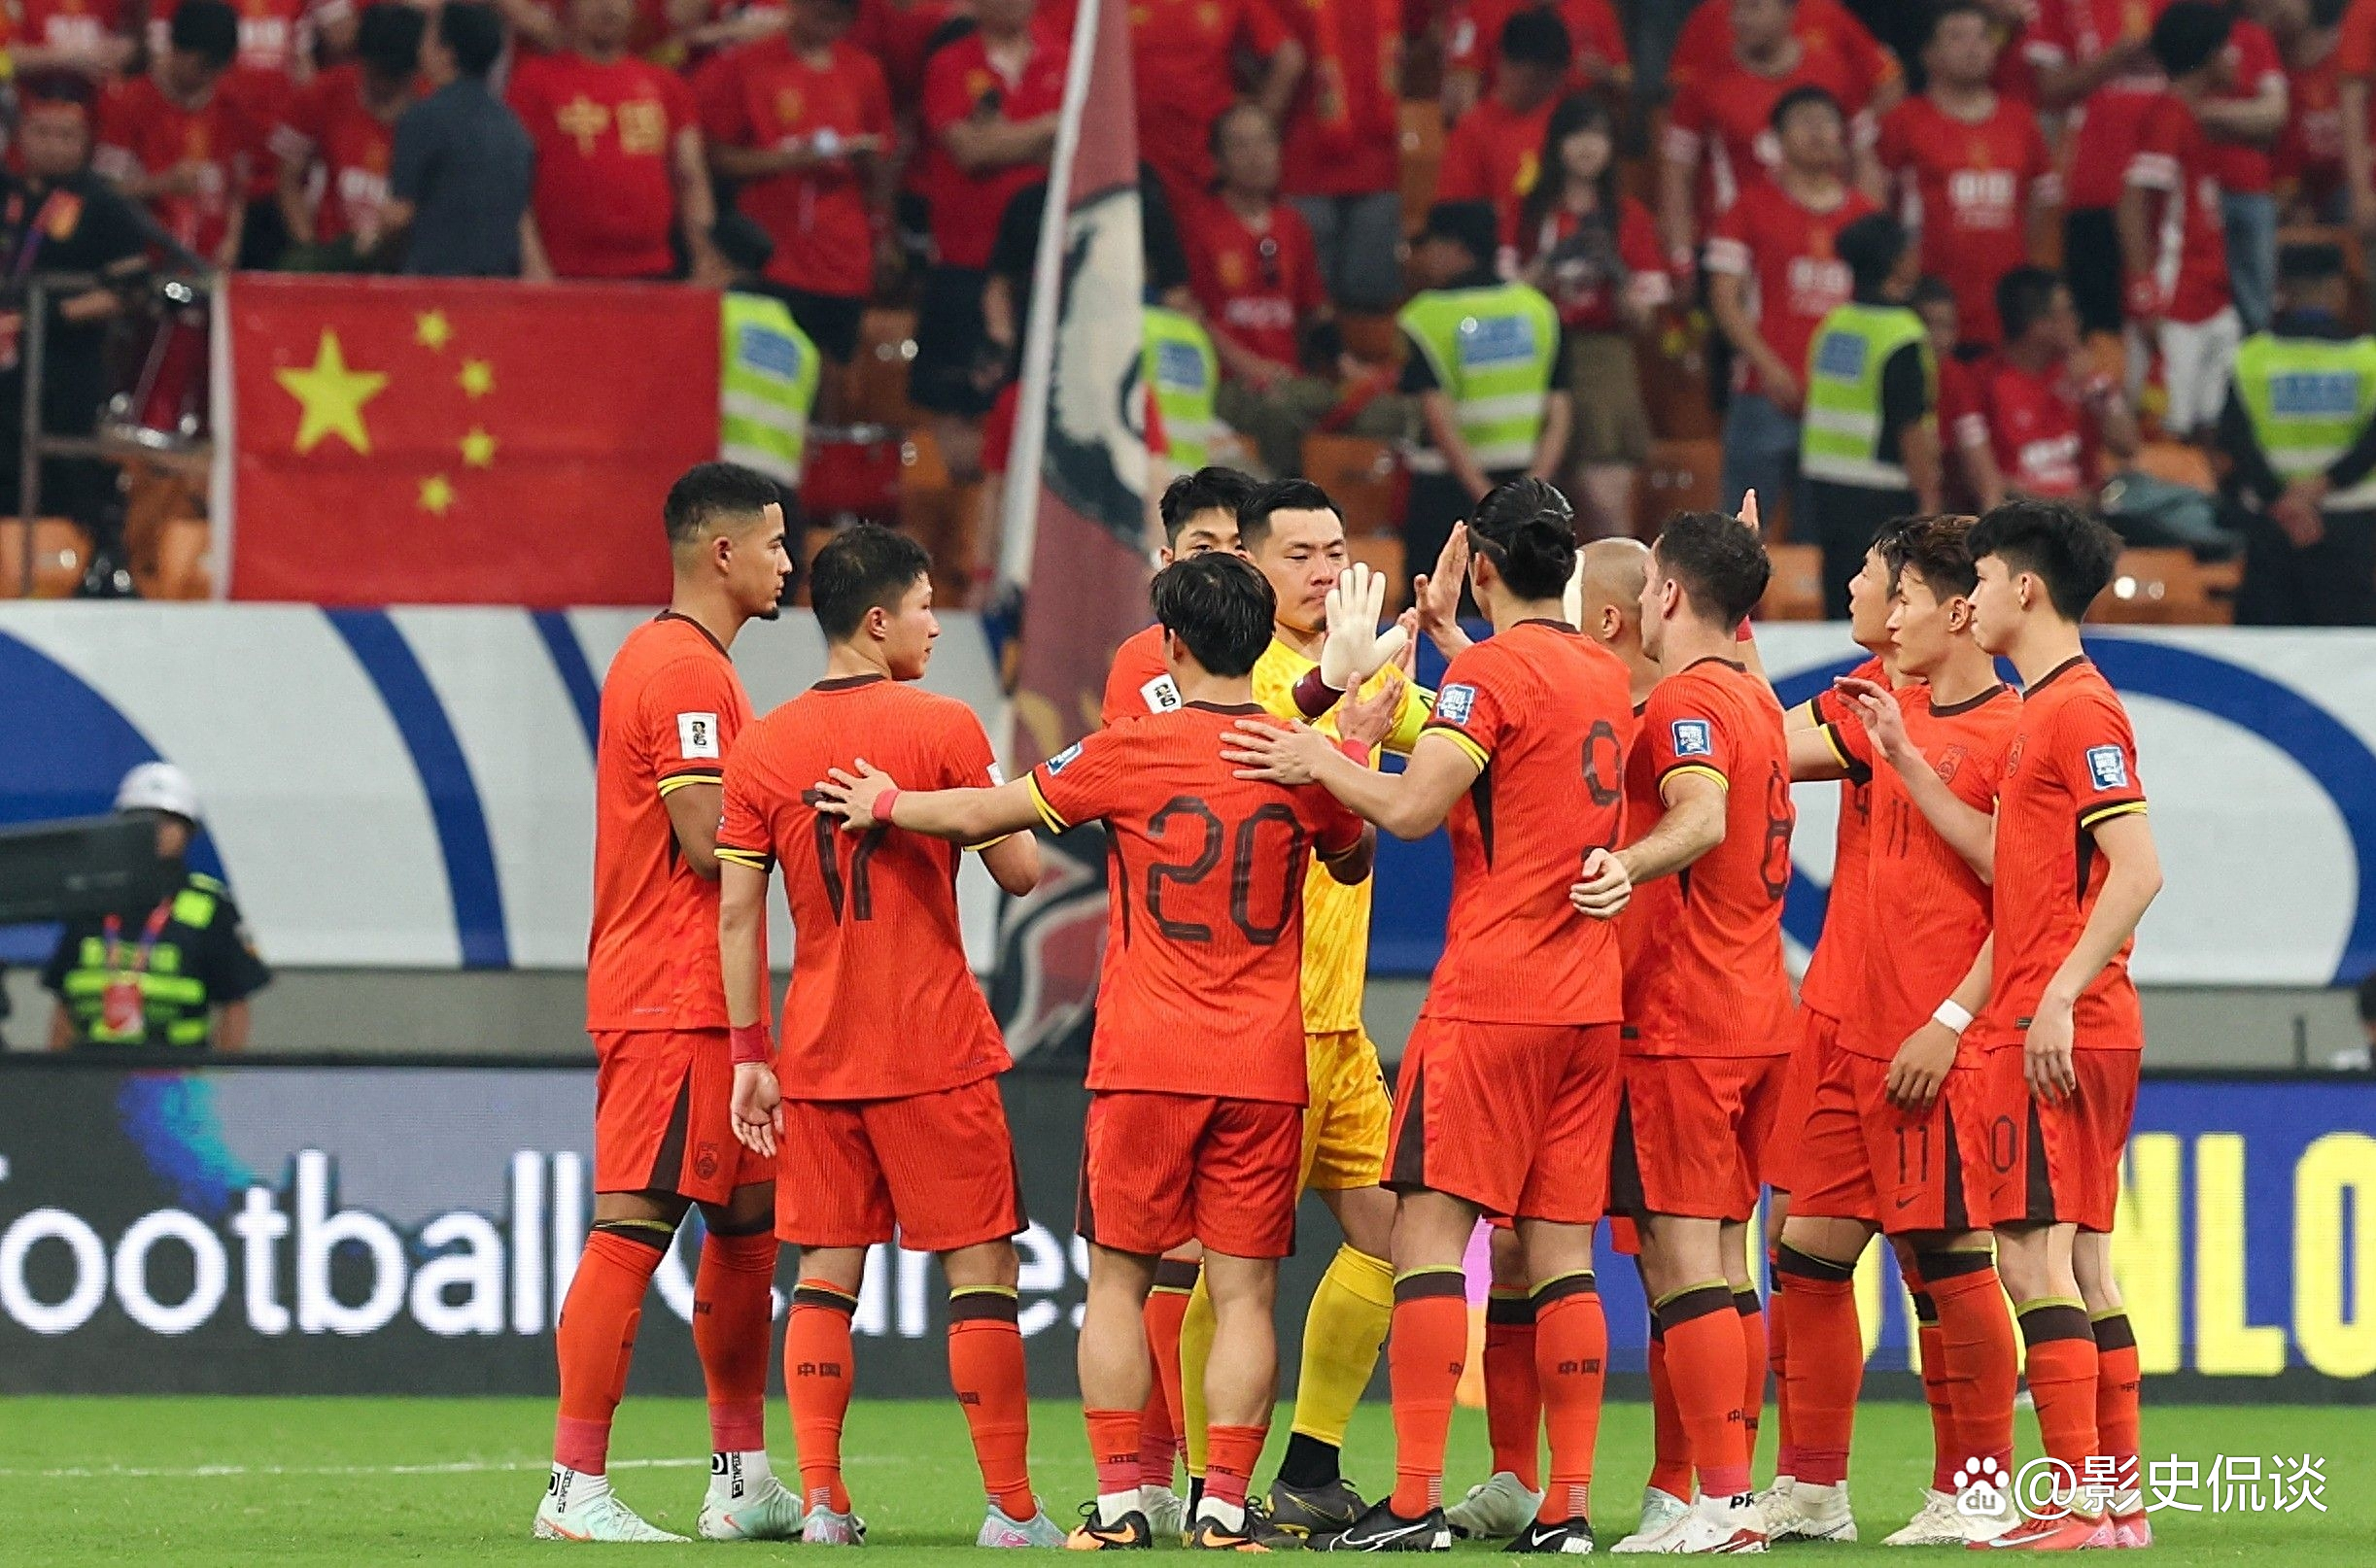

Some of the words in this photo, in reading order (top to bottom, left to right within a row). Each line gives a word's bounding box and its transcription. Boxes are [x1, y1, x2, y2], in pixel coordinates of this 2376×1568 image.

[557, 94, 668, 155] 中国
[1582, 720, 1622, 863] 9
[1760, 760, 1793, 901] 8
[1887, 797, 1911, 860] 11
[1147, 796, 1305, 945] 20
[1896, 1125, 1928, 1184] 11
[0, 1148, 589, 1338] ootball
[797, 1362, 842, 1379] 中国
